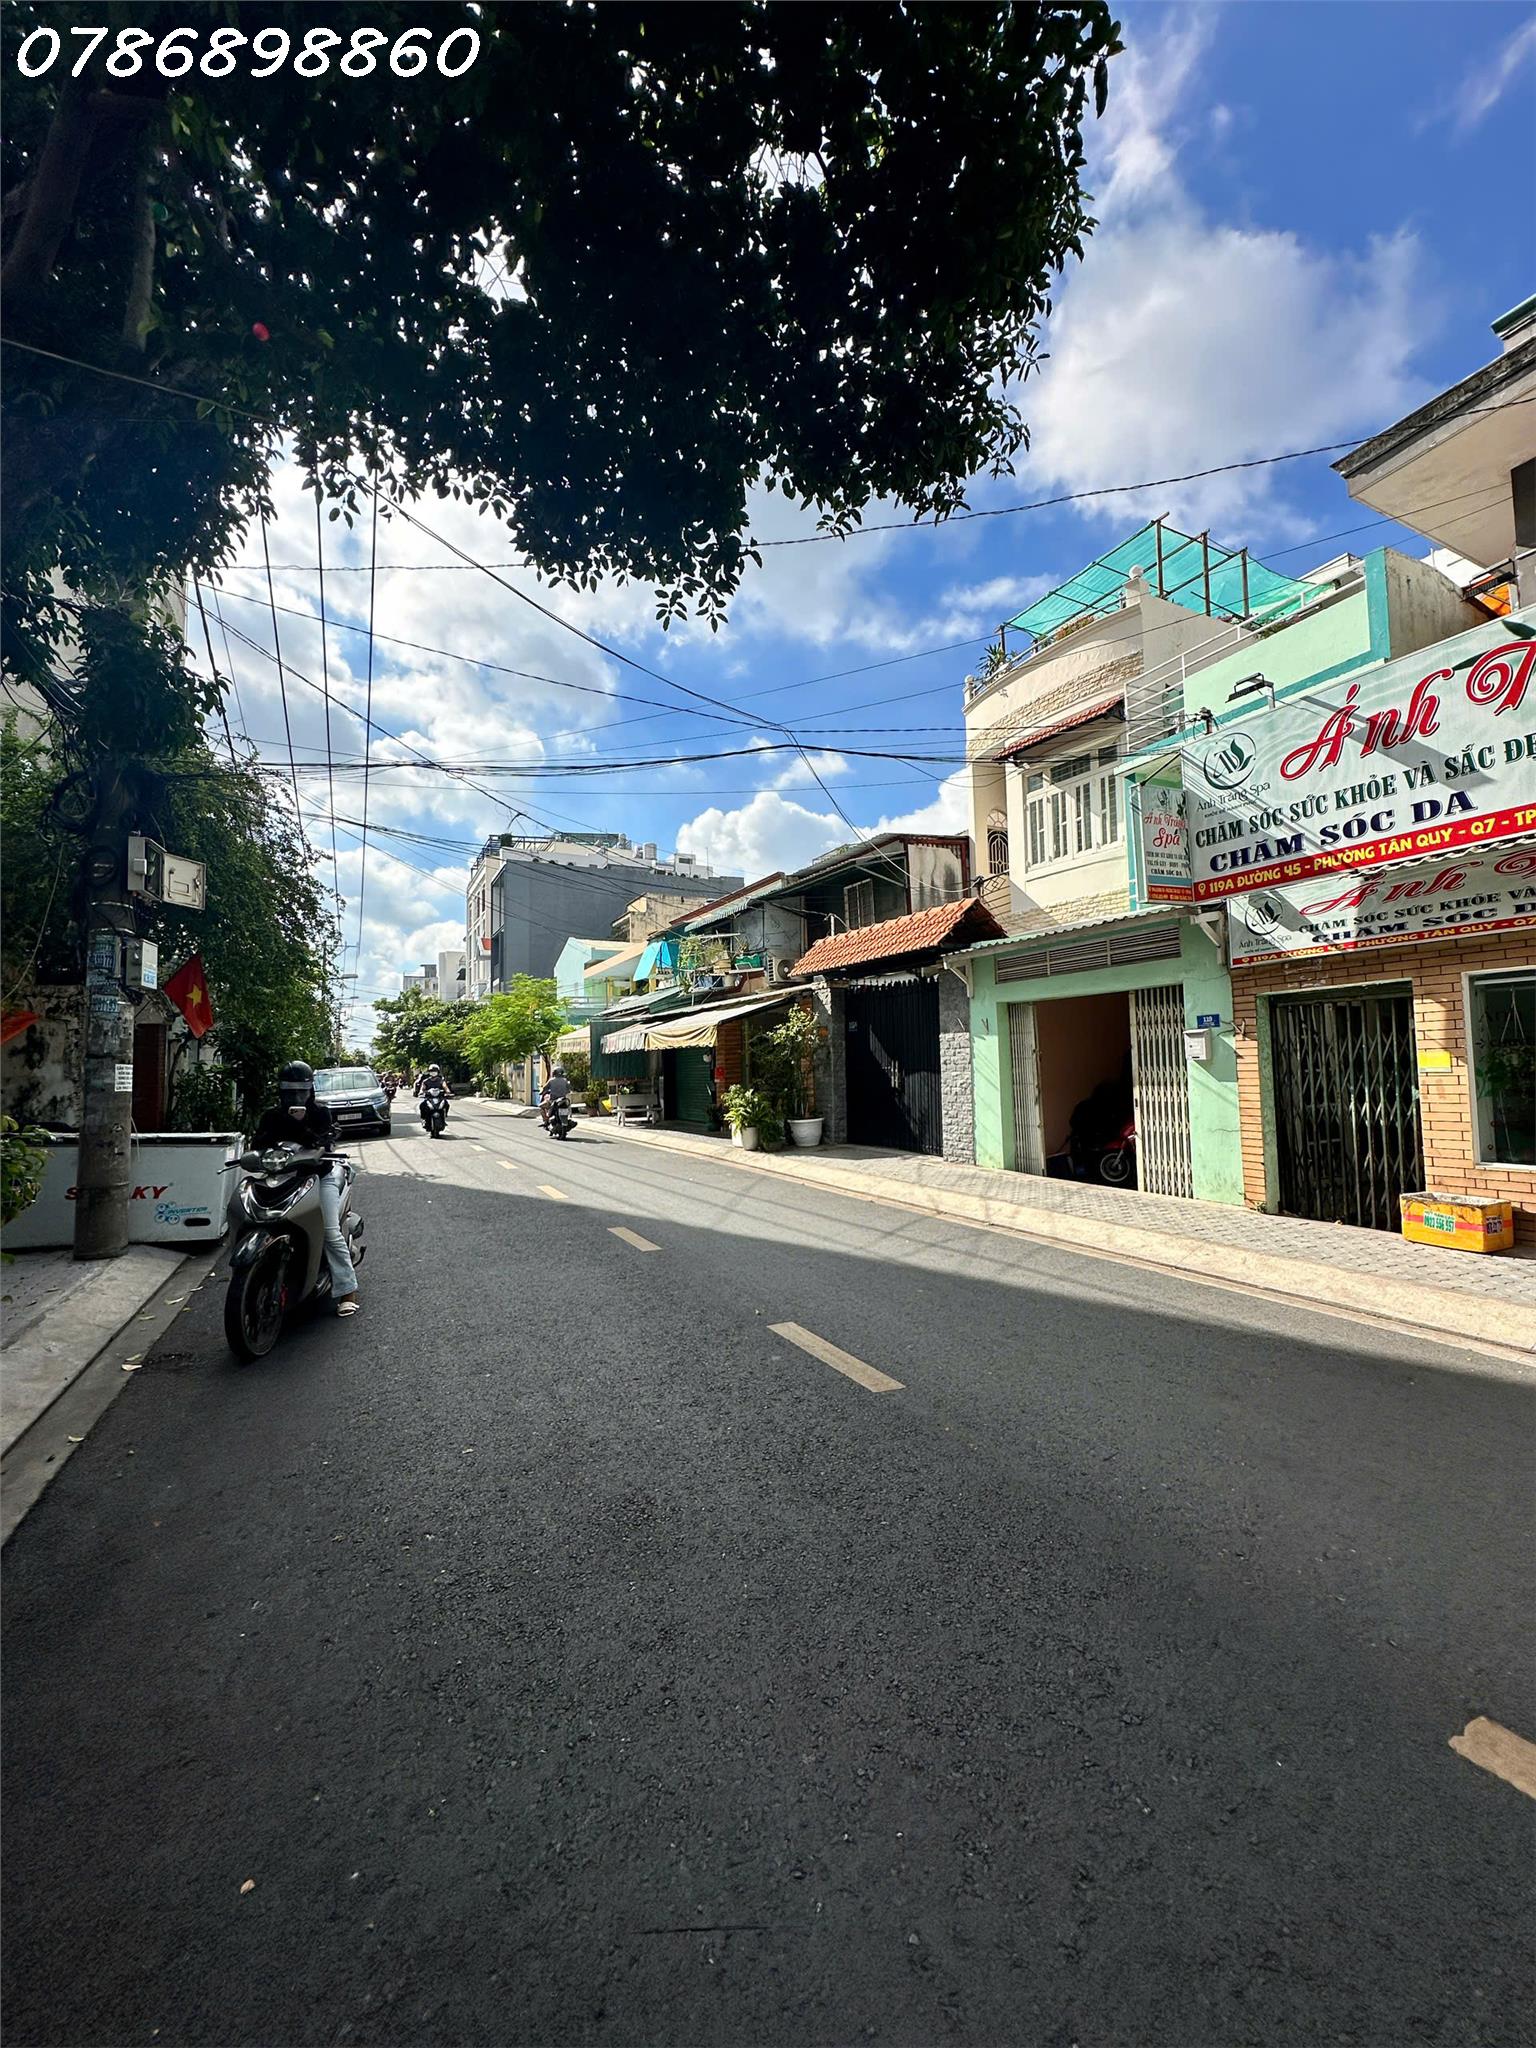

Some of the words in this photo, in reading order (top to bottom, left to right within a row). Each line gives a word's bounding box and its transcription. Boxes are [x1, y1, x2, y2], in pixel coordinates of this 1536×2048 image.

[1280, 667, 1454, 780] Ánh
[1196, 819, 1244, 848] CHĂM
[1249, 807, 1284, 834] SÓC
[1290, 793, 1328, 822] SỨC
[1334, 774, 1397, 809] KHỎE
[1403, 761, 1438, 790] VÀ
[1444, 743, 1495, 780] SẮC
[1210, 832, 1306, 872] CHĂM
[1319, 809, 1395, 845] SÓC
[1411, 790, 1478, 825] DA
[1209, 881, 1235, 894] 119A
[1237, 867, 1281, 887] ĐƯỜNG
[1284, 863, 1301, 878] 45
[1314, 845, 1375, 871] PHƯỜNG
[1380, 837, 1411, 856] TÂN
[1417, 827, 1453, 848] QUY
[1470, 818, 1495, 836] Q7
[1353, 910, 1388, 925] SÓC
[1422, 907, 1498, 928] SÓC
[1422, 927, 1455, 939] TÂN
[1460, 922, 1495, 934] QUY
